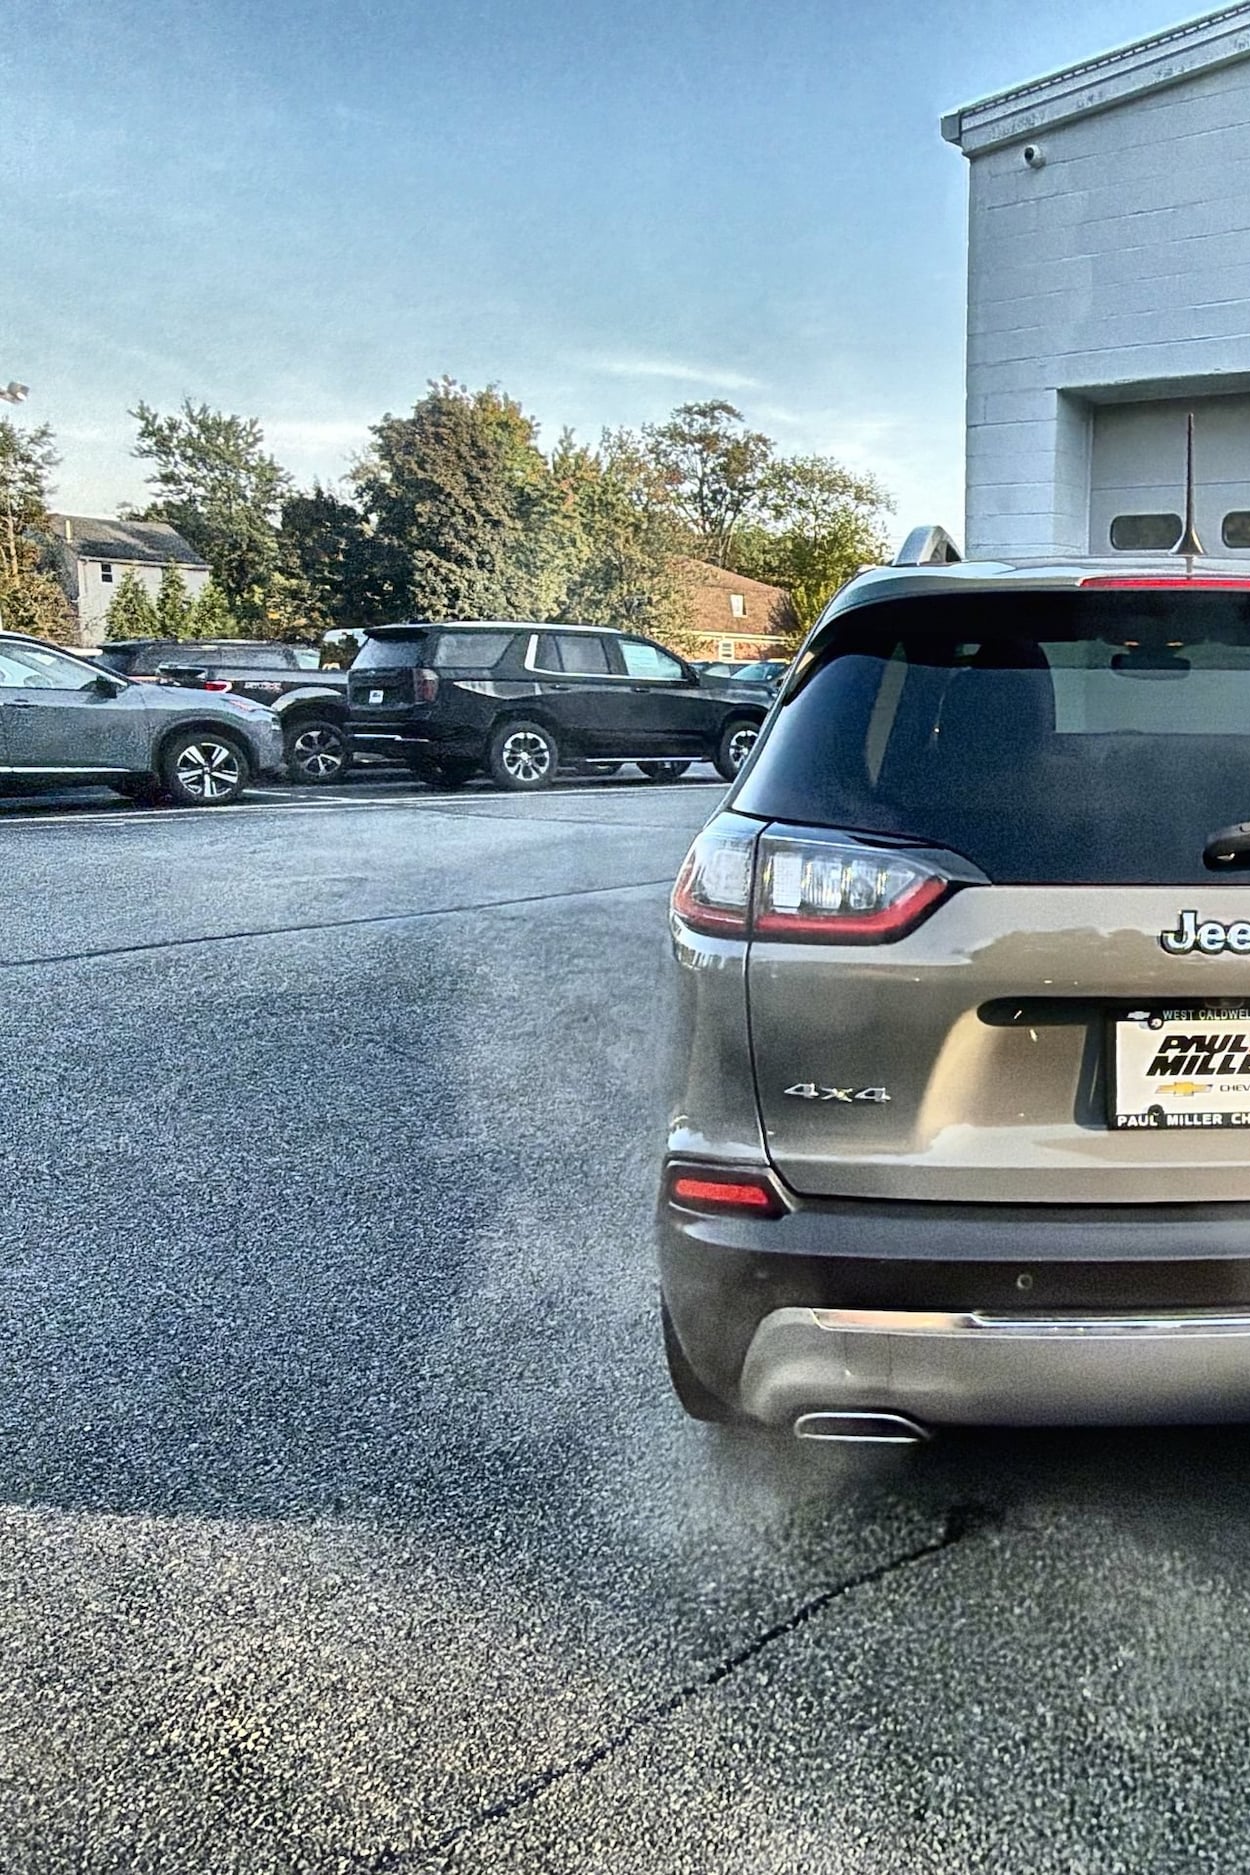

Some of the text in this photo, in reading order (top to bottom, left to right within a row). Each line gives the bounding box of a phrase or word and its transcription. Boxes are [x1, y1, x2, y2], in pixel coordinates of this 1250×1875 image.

[1162, 1009, 1194, 1020] WEST
[1158, 1034, 1250, 1055] PAUL
[1117, 1114, 1159, 1127] PAUL
[1166, 1113, 1223, 1126] MILLER
